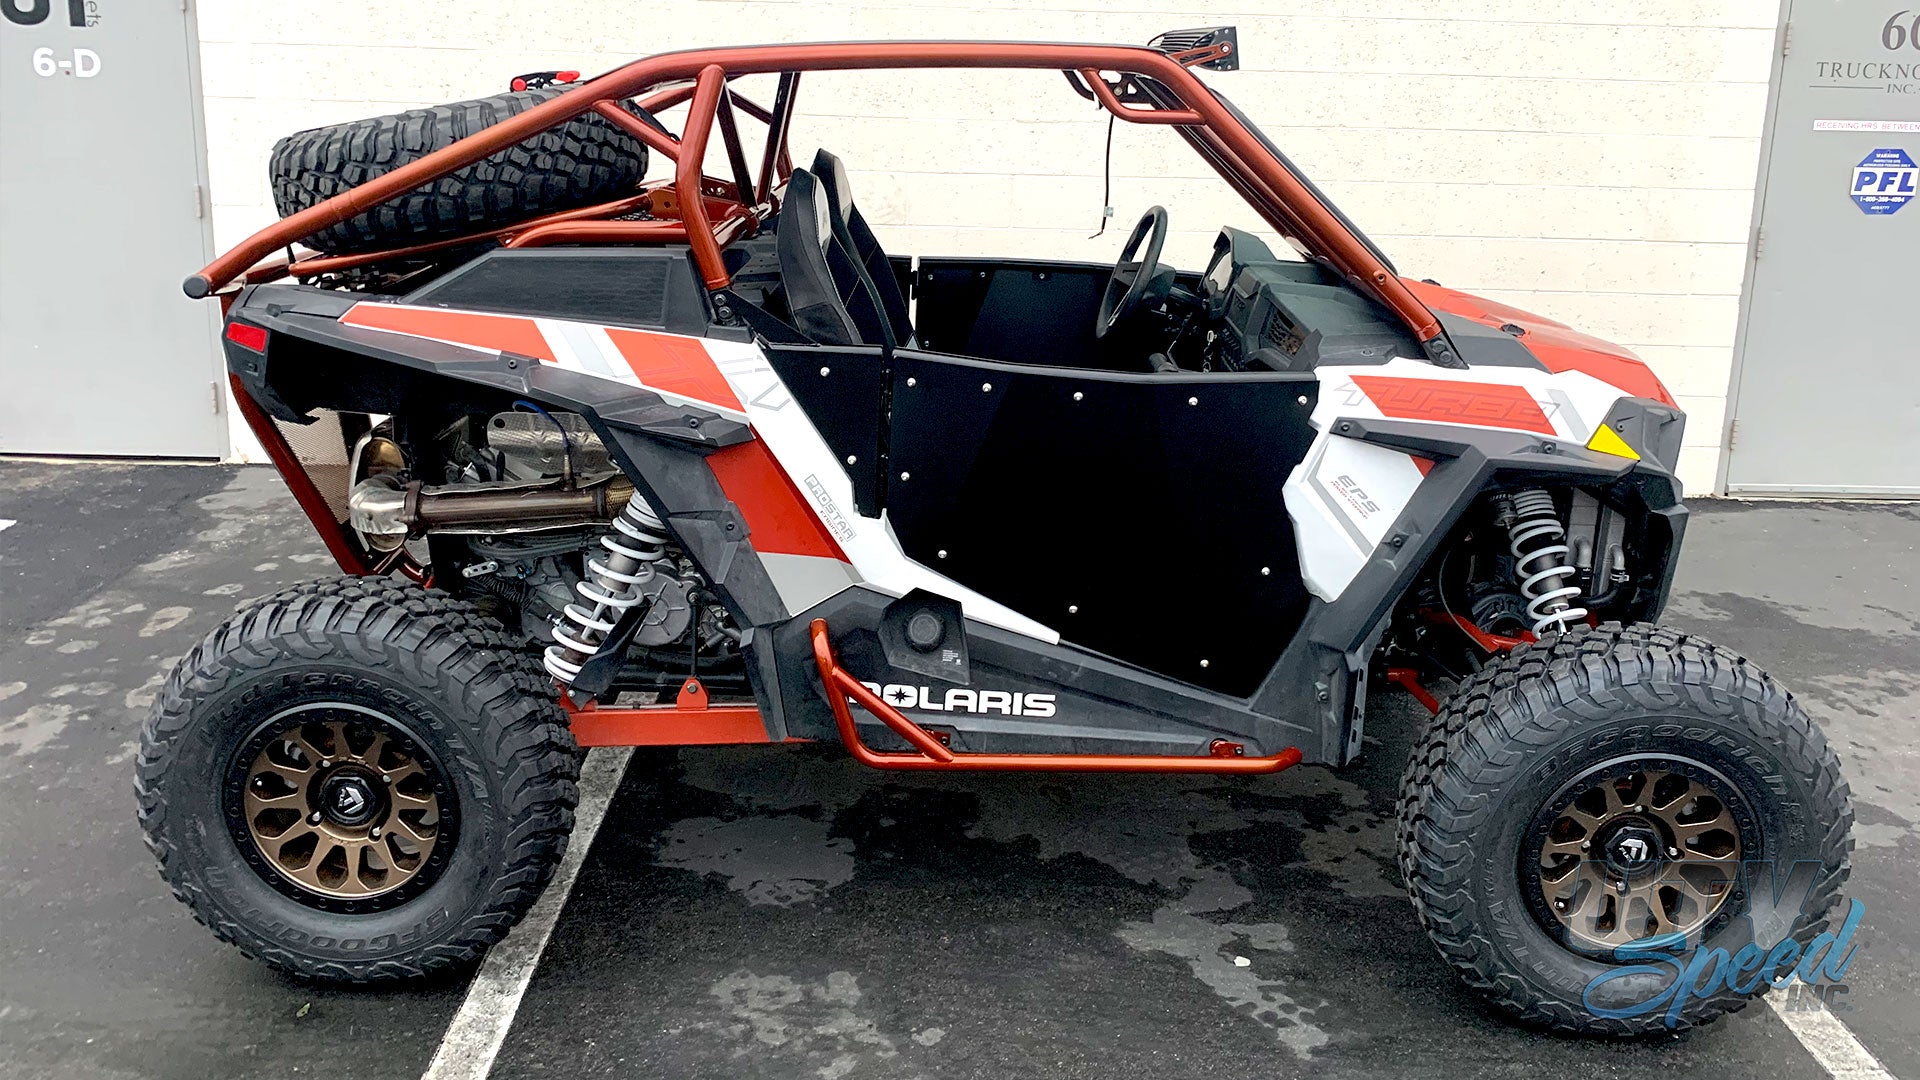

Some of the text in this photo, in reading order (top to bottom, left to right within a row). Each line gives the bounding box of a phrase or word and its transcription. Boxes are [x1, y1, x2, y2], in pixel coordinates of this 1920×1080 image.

[32, 47, 101, 78] 6-D
[1886, 83, 1917, 95] INC.
[1854, 171, 1915, 192] PFL
[1333, 380, 1561, 430] TURBO
[804, 474, 856, 542] PROSTAR
[1338, 474, 1380, 513] EPS
[1532, 723, 1789, 797] BFGoodrich
[205, 866, 449, 952] BFGoodrich
